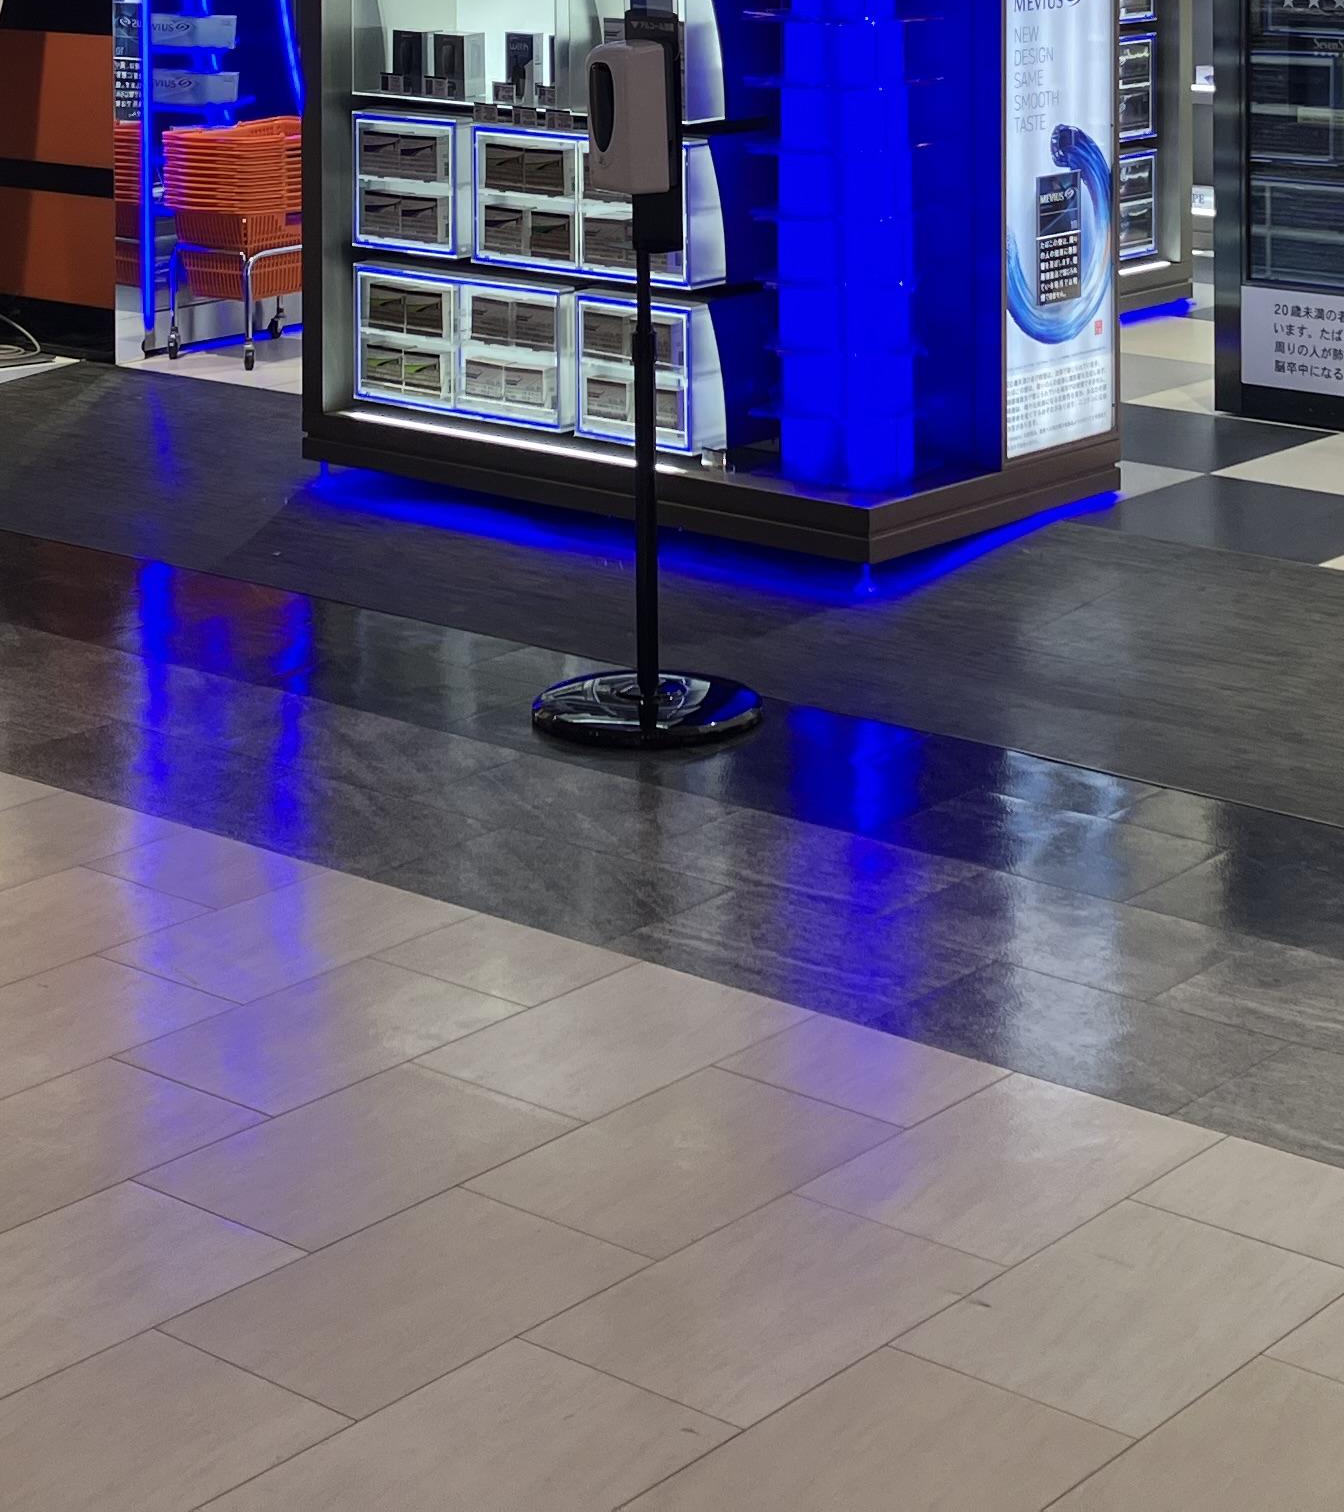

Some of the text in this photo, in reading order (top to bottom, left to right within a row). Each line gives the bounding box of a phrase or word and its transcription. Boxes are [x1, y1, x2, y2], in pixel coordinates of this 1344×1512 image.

[1014, 25, 1040, 44] NEW
[1014, 46, 1055, 66] DESIGN
[1014, 70, 1044, 89] SAME
[1014, 90, 1061, 111] SMOOTH
[1014, 114, 1047, 134] TASTE
